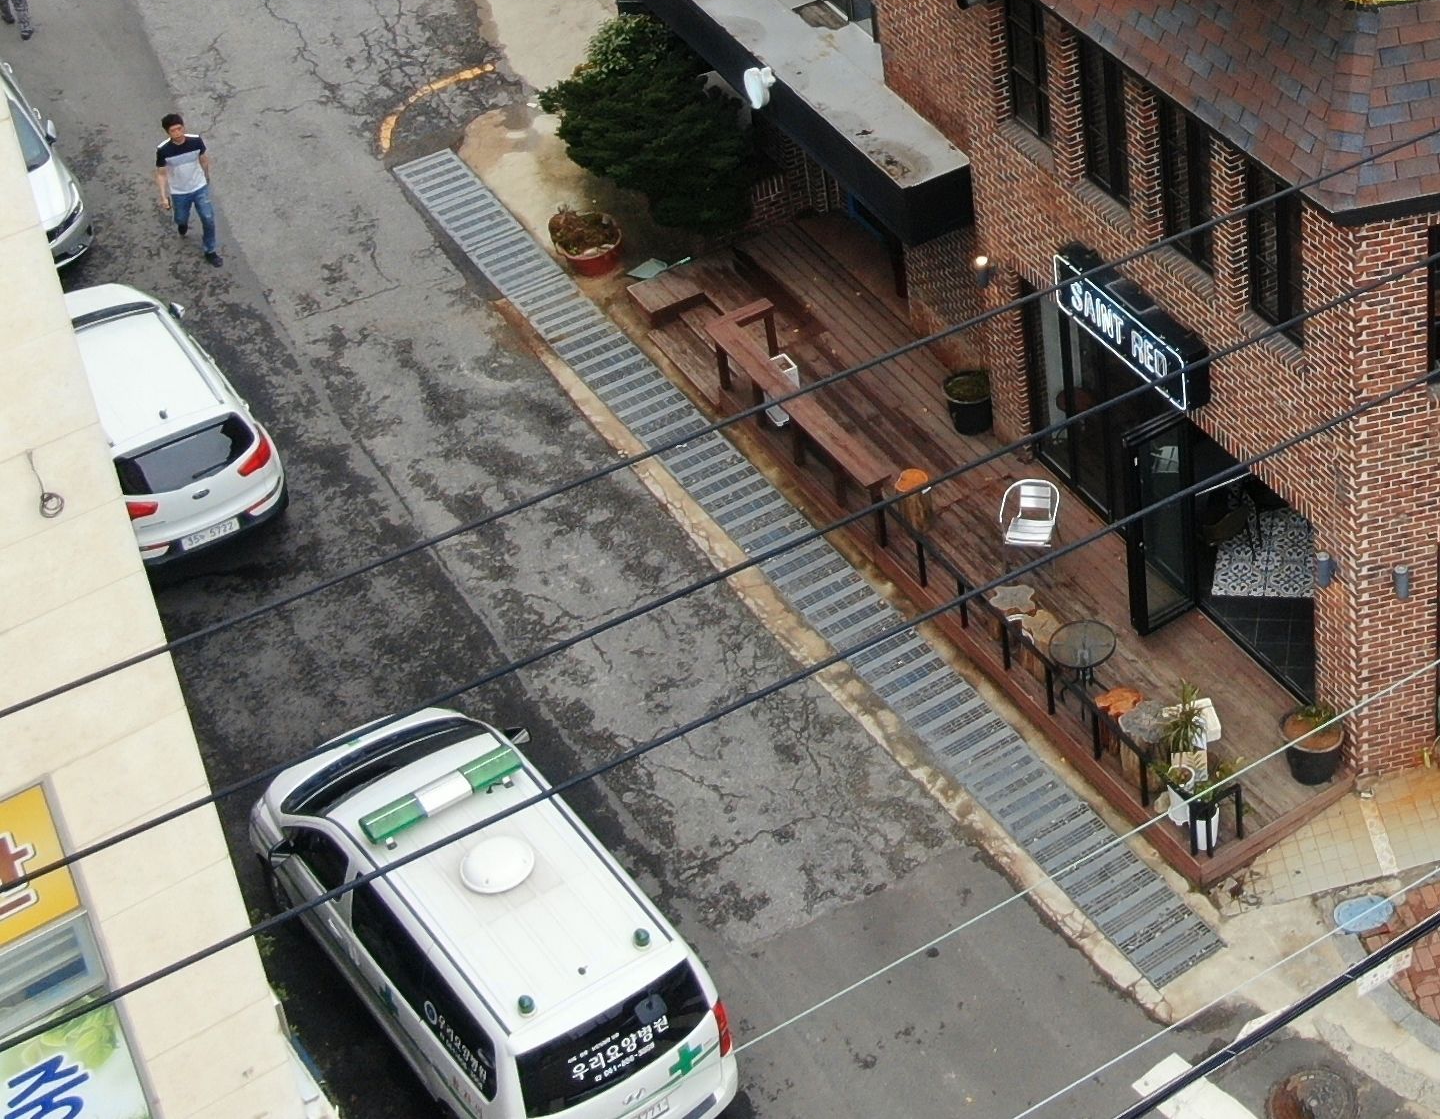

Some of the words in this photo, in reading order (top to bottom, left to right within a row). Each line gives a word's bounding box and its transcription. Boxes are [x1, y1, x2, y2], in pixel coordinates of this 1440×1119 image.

[1070, 281, 1124, 345] SAINT
[1131, 330, 1168, 378] RED
[571, 1014, 669, 1081] 우리요양병원
